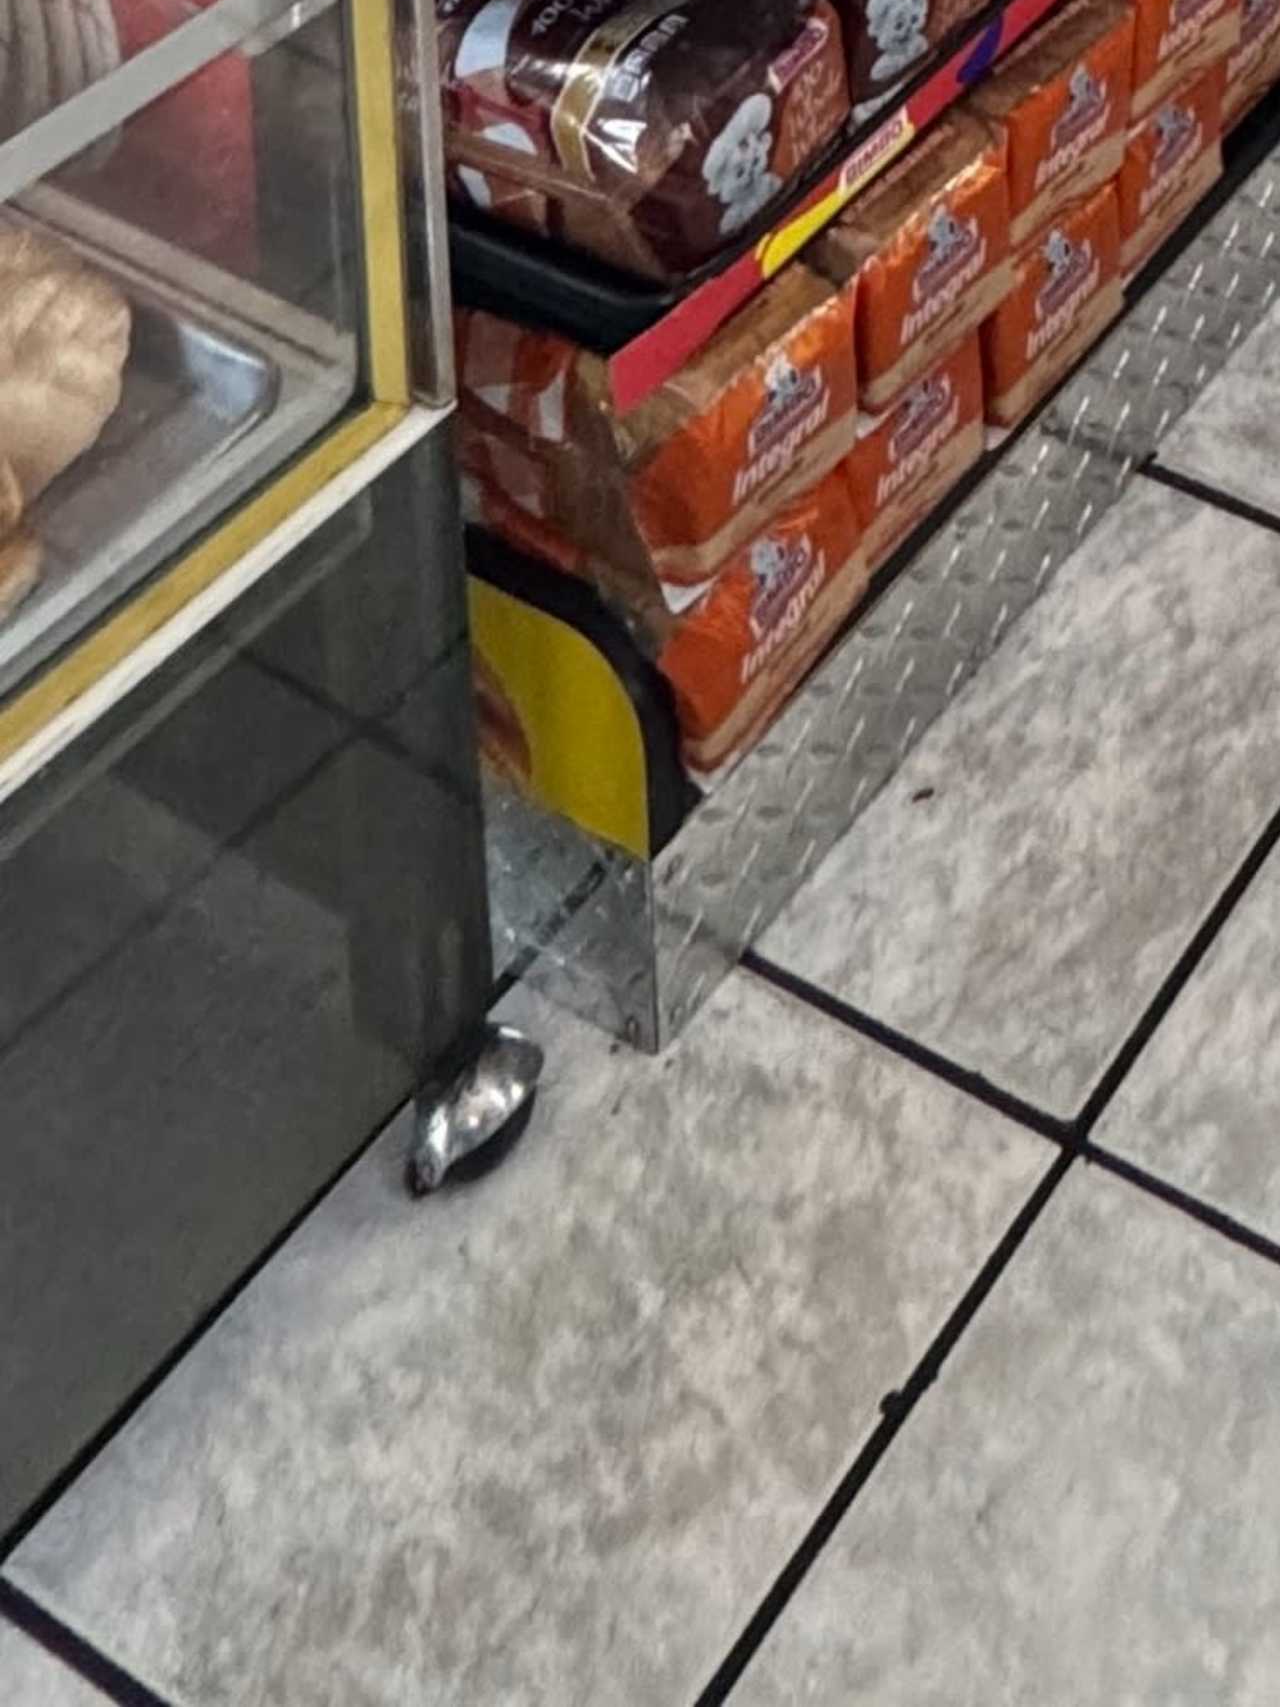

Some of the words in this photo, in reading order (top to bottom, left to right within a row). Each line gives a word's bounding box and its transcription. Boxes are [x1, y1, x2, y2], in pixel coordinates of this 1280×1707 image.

[845, 113, 904, 180] BIMBO
[902, 249, 986, 341] Integral
[733, 402, 830, 506] Integral
